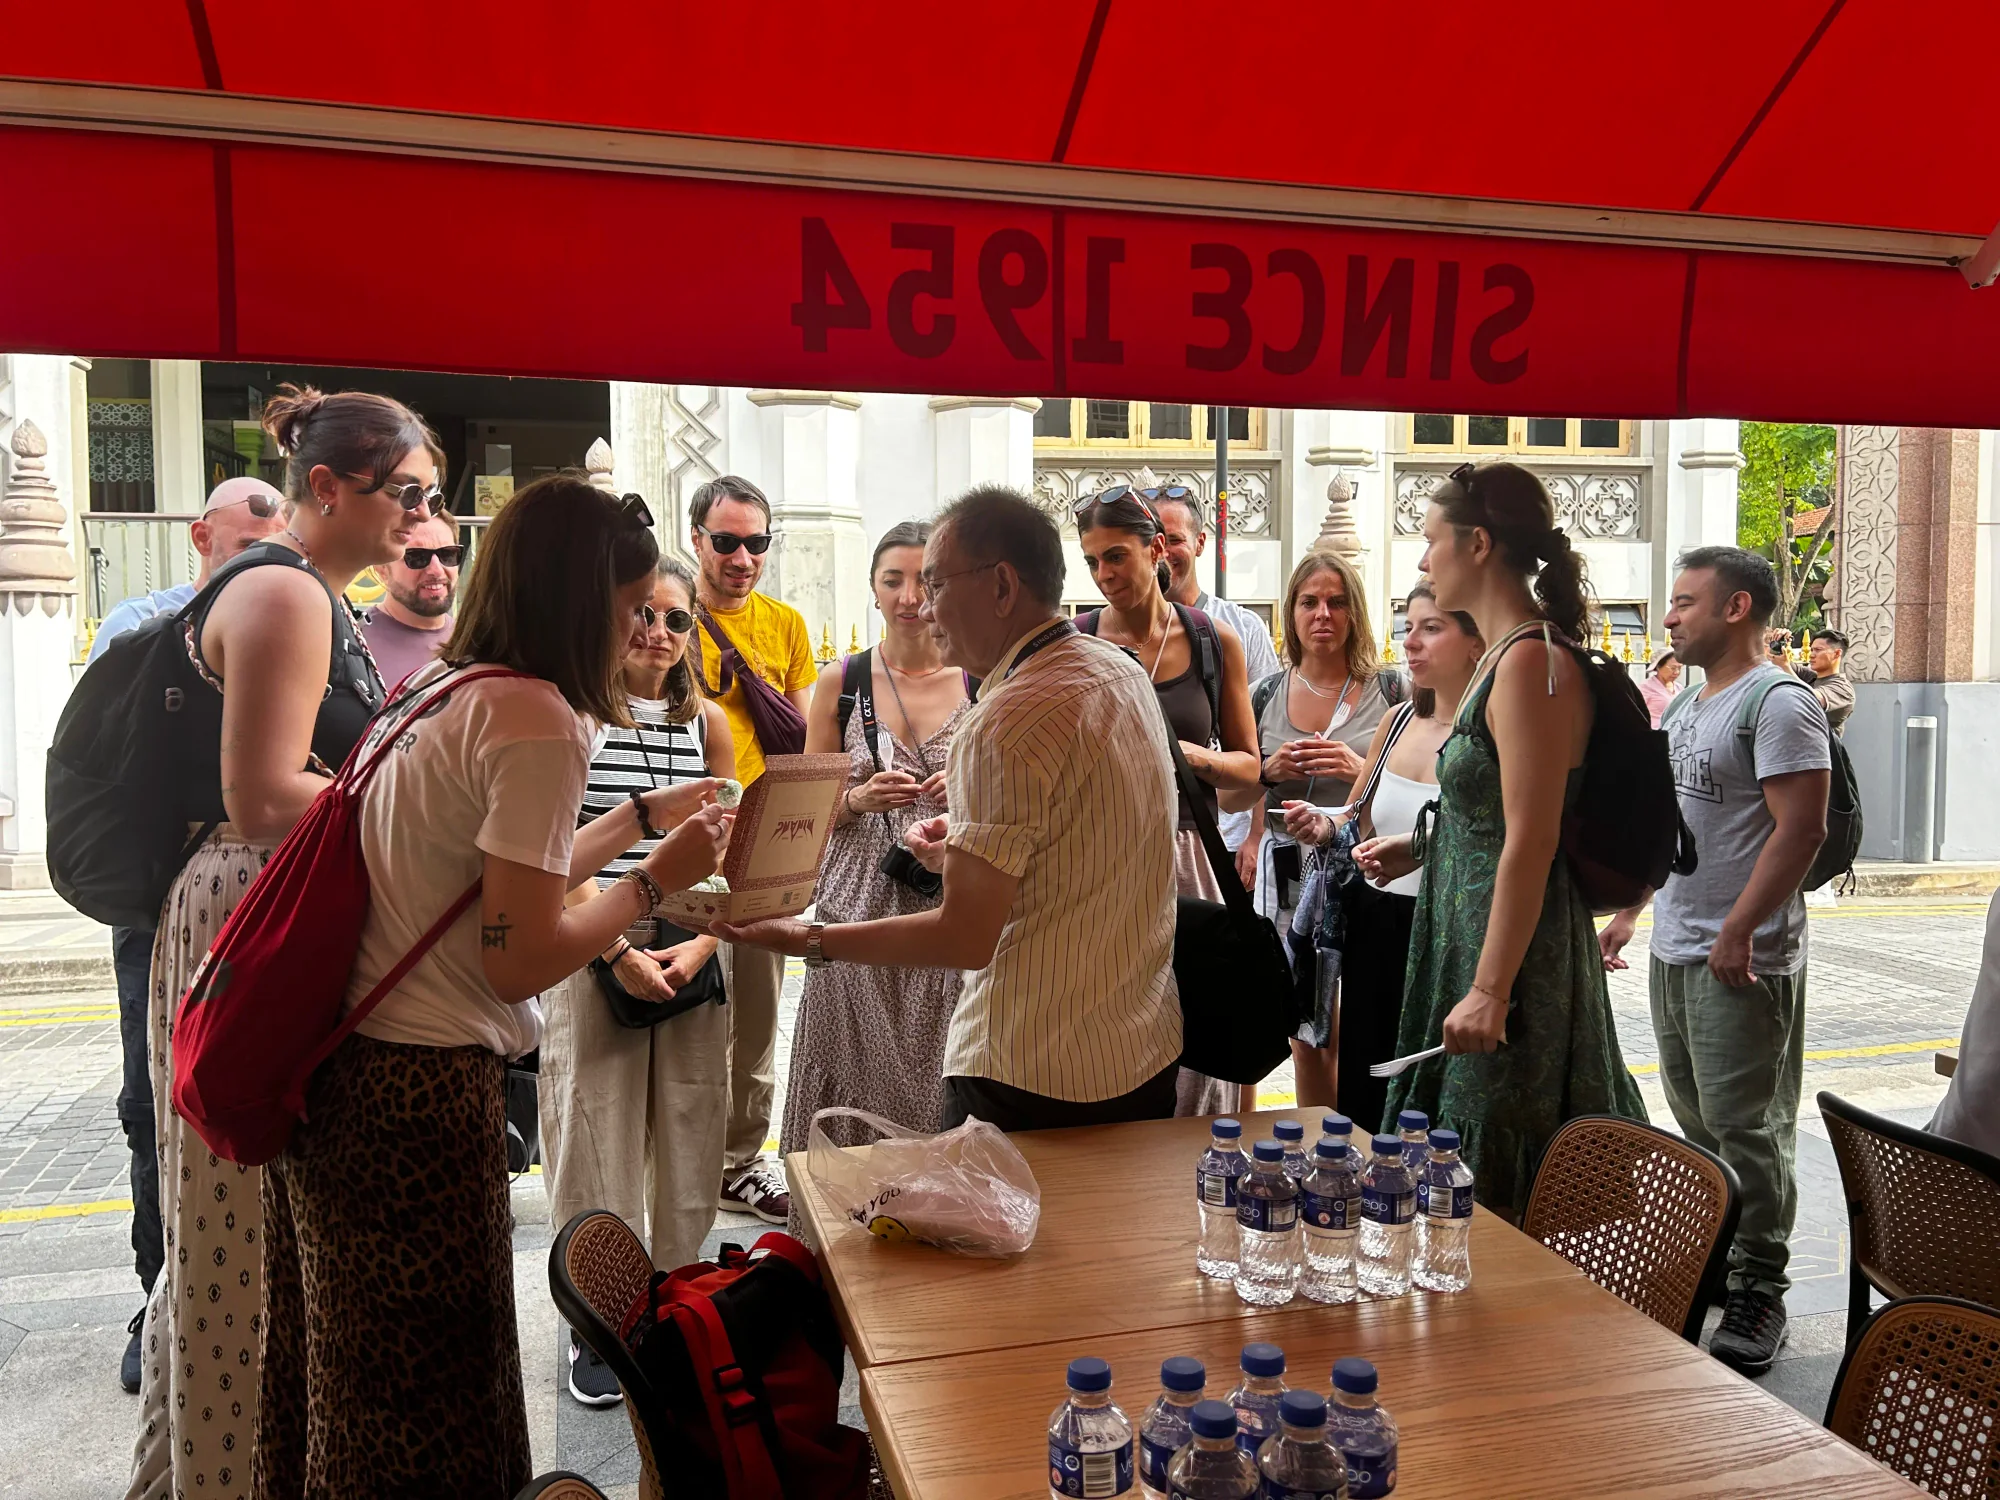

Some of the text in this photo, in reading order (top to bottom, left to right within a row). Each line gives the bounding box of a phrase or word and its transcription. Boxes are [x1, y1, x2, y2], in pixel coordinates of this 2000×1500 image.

[1032, 622, 1070, 648] SINGAPORE
[766, 818, 816, 848] MINANG
[738, 1182, 765, 1207] N
[869, 1187, 901, 1212] YOU
